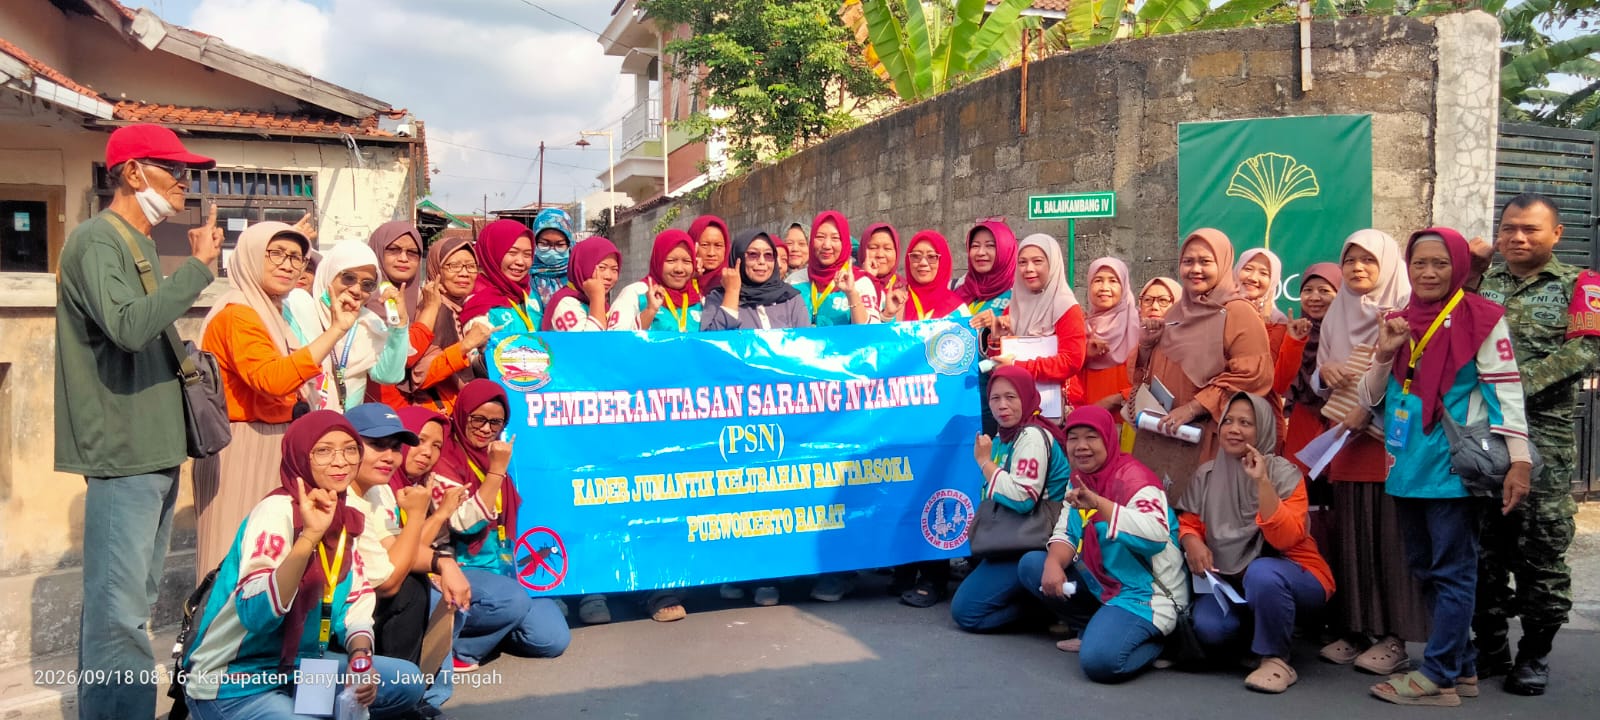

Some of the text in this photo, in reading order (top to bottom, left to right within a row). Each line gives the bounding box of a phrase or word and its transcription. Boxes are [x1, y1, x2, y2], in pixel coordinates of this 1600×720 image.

[1043, 198, 1100, 214] BALAIKAMBANG
[1100, 198, 1109, 211] IV
[554, 310, 579, 332] 99
[525, 373, 939, 427] PEMBERANTASAN SARANG NYAMUK
[718, 423, 785, 463] (PSN)
[572, 477, 630, 506] KADER
[631, 471, 716, 502] JUMANTIK
[812, 456, 914, 489] BANTARSOKA
[1016, 457, 1039, 480] 99
[686, 504, 846, 543] PURWOKERTO BARAT
[922, 518, 942, 546] DEMAM
